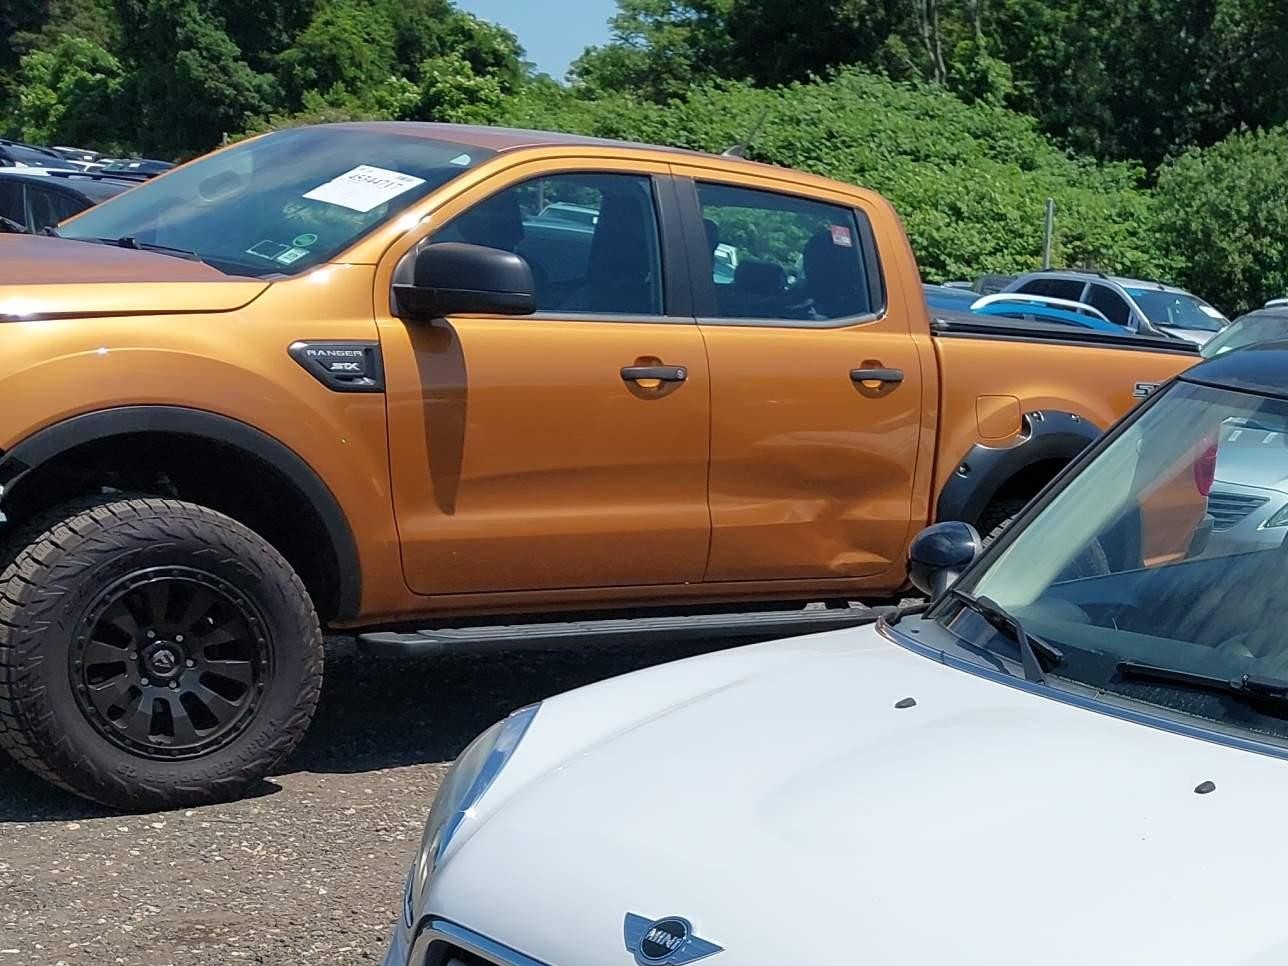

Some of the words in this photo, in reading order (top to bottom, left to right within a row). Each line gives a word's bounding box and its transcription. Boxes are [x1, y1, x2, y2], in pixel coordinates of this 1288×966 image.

[306, 348, 364, 357] RANGER
[330, 361, 361, 371] STX
[645, 926, 683, 950] MINI
